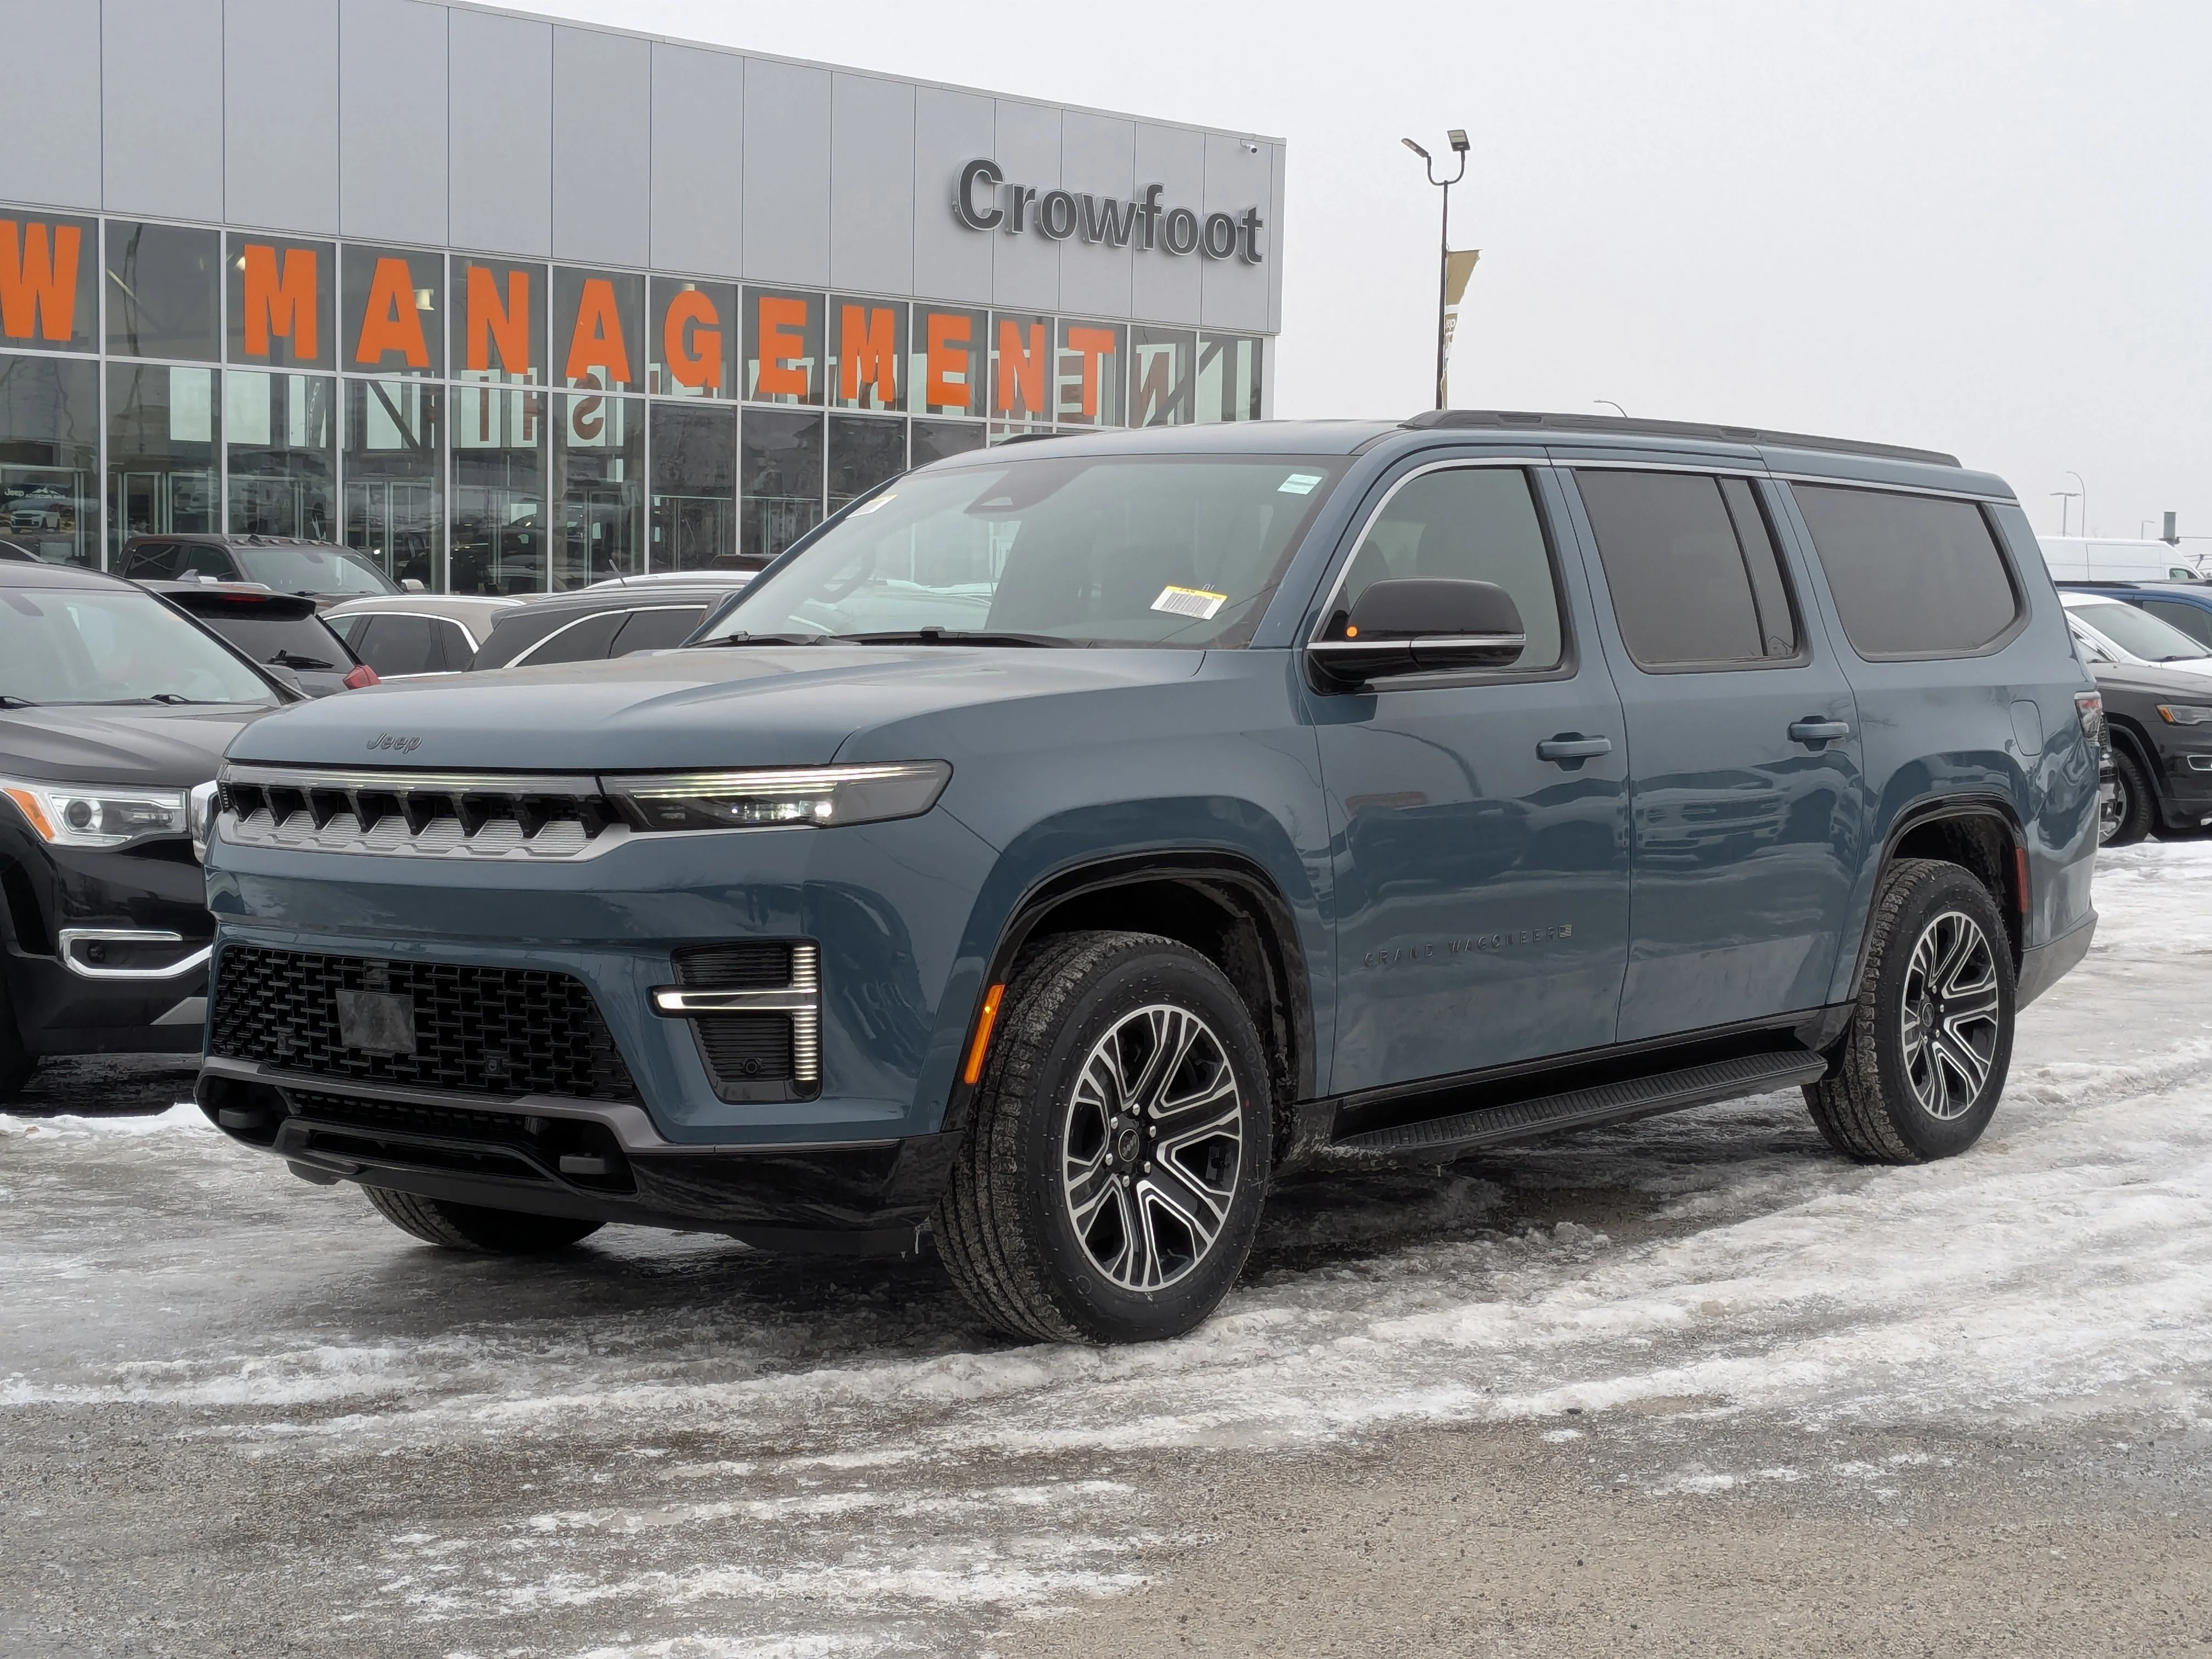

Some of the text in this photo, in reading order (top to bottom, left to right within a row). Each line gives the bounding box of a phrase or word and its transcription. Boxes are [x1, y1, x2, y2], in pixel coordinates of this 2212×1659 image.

[955, 157, 1263, 264] Crowfoot
[245, 245, 1114, 415] MANAGEMENT
[366, 732, 422, 754] Jeep
[1363, 926, 1555, 967] GRAND WAGONEER
